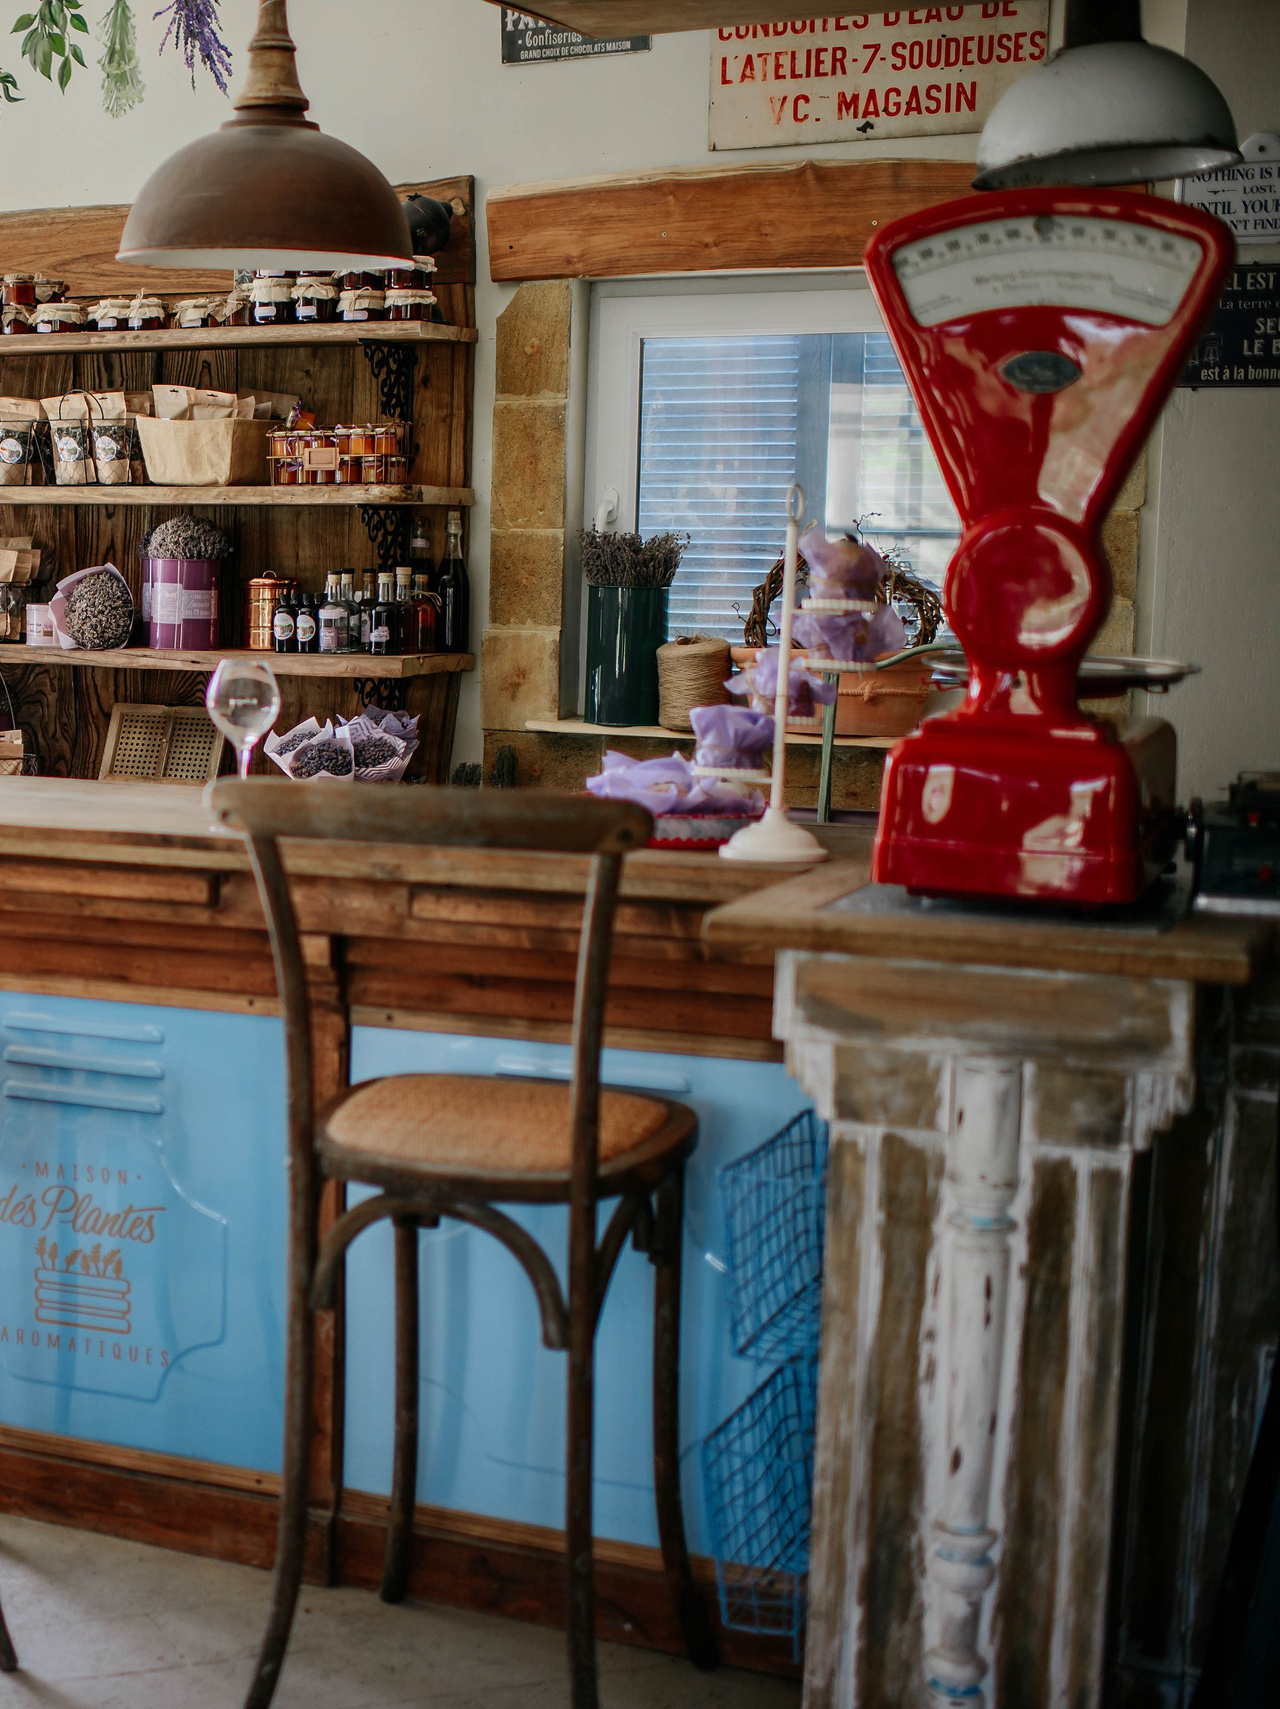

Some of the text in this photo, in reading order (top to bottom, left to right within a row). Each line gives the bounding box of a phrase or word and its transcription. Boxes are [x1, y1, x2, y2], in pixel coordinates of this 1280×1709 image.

[520, 40, 631, 60] GRAND CHOIX DE CHOCOLATS MAISON
[837, 82, 977, 120] MAGASIN
[1260, 167, 1273, 179] IS
[1246, 272, 1277, 290] EST
[1238, 299, 1271, 309] terre
[1243, 339, 1265, 355] LE
[1201, 366, 1220, 380] est
[1223, 365, 1230, 380] à
[1234, 364, 1244, 380] la
[35, 1161, 128, 1186] MAISON
[41, 1185, 166, 1244] Plantes
[1, 1326, 170, 1368] AROMATIQUES
